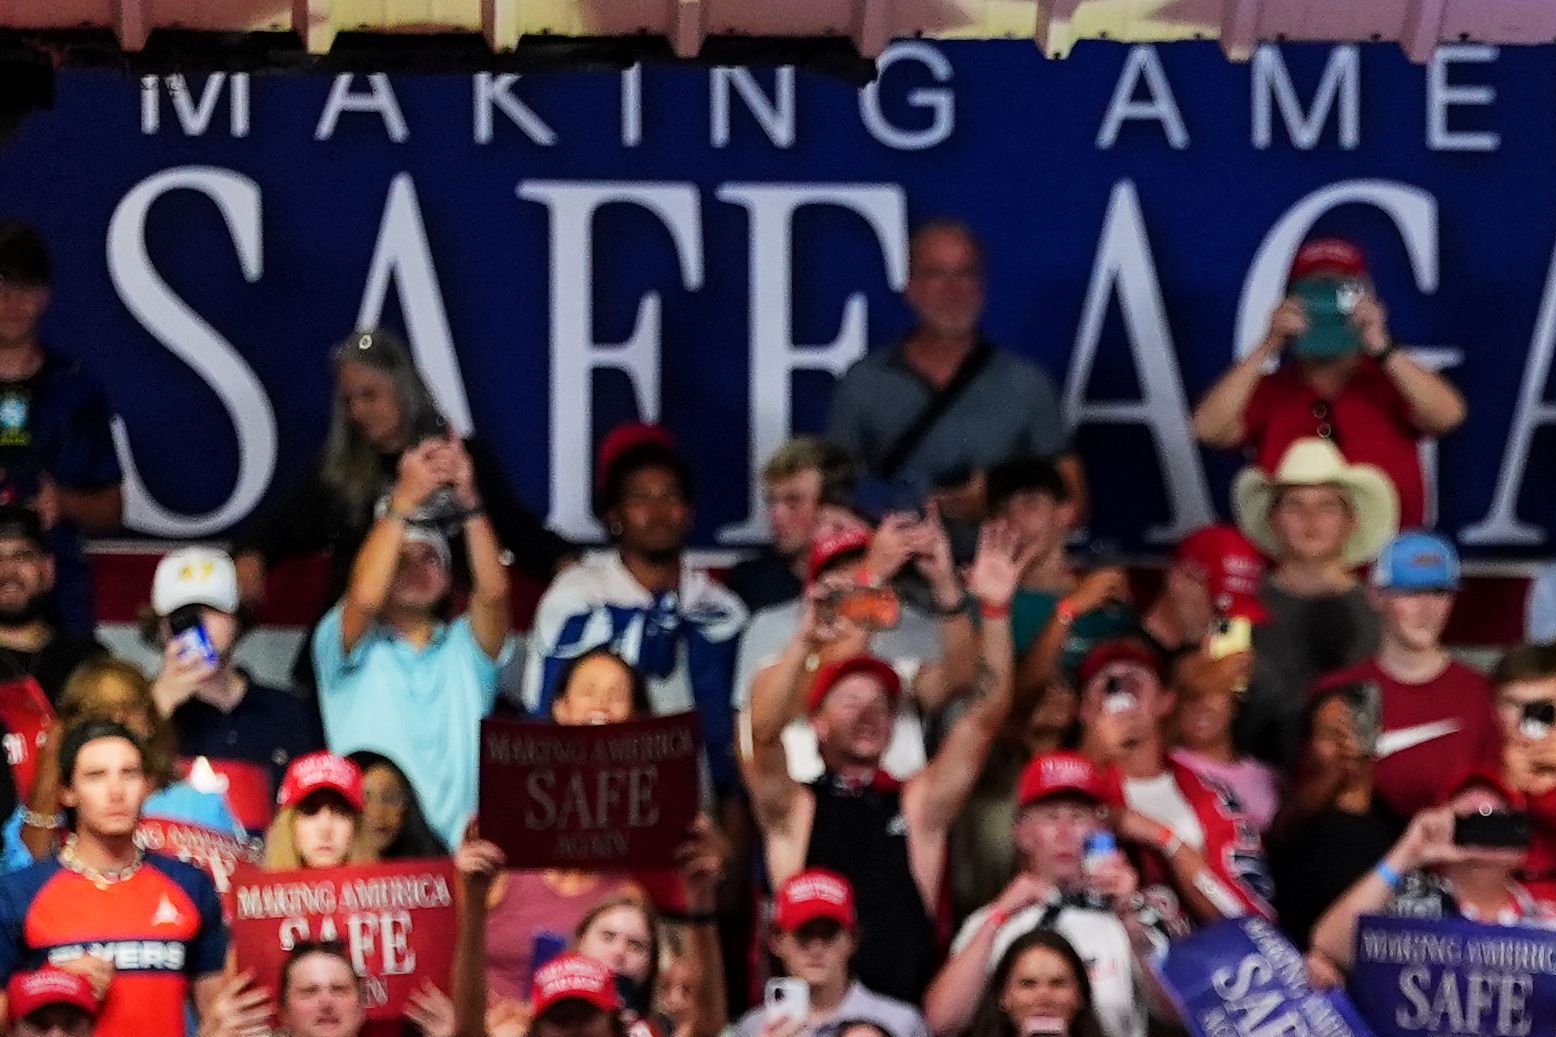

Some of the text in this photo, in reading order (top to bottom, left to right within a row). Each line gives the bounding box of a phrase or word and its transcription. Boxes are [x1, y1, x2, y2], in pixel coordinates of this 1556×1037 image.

[139, 40, 957, 151] MAKING
[524, 763, 661, 831] SAFE
[1395, 964, 1534, 1037] SAFE
